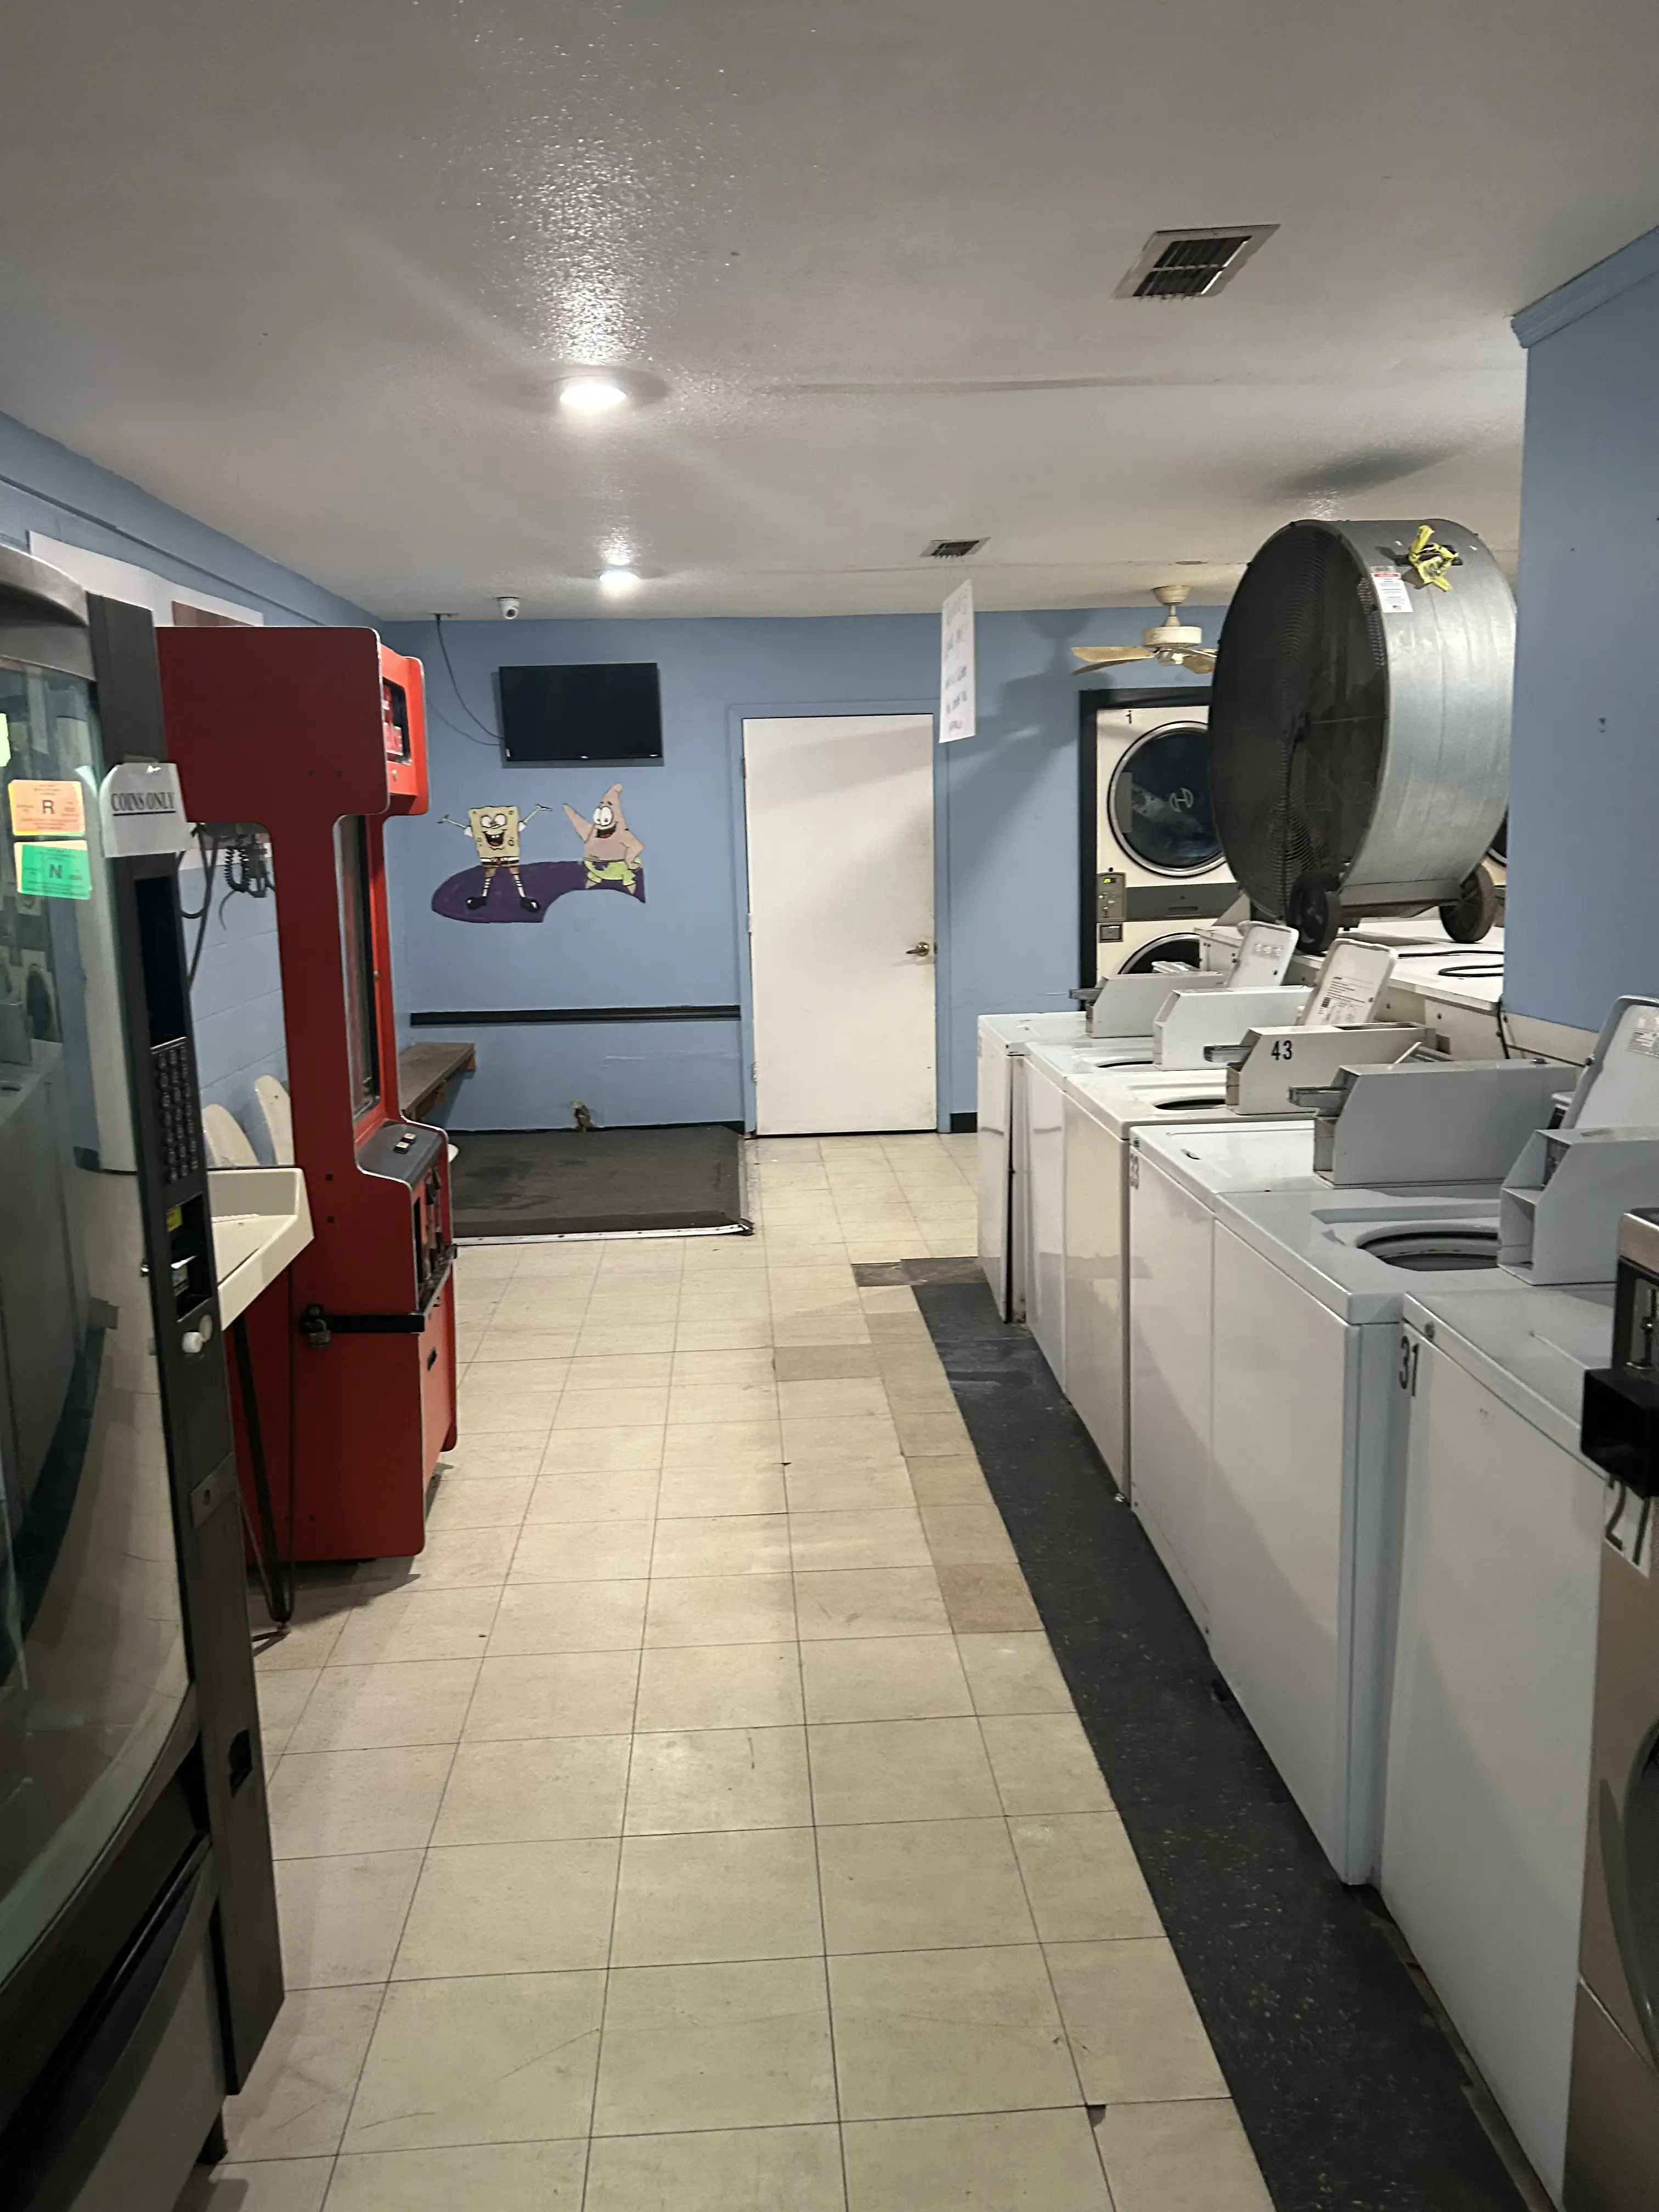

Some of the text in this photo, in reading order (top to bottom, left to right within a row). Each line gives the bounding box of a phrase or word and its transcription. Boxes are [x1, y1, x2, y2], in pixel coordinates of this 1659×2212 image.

[42, 799, 55, 814] R
[111, 792, 175, 811] COINS ONLY
[49, 864, 63, 879] N
[1271, 1040, 1292, 1060] 43
[1399, 1335, 1420, 1397] 31
[1605, 1475, 1650, 1566] 21
